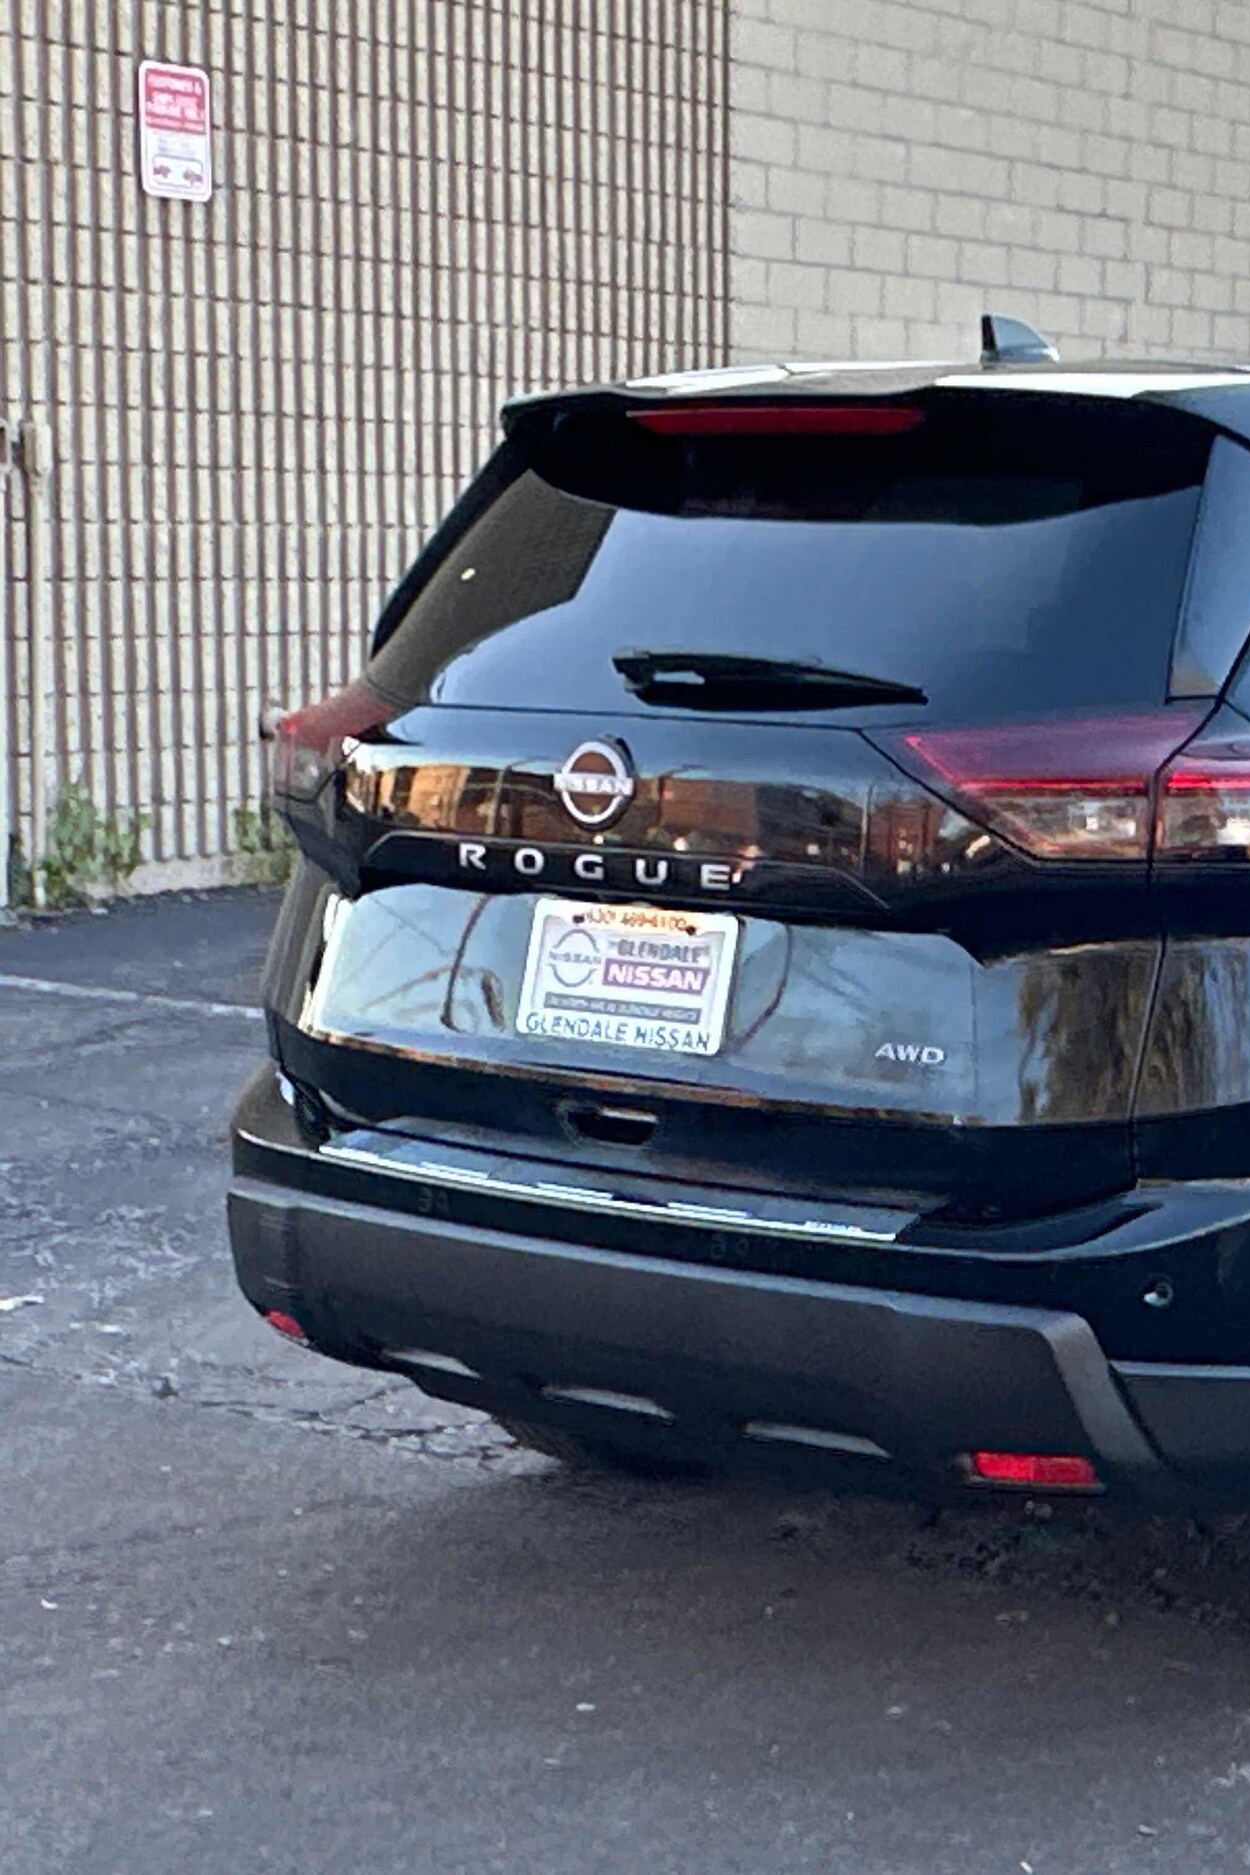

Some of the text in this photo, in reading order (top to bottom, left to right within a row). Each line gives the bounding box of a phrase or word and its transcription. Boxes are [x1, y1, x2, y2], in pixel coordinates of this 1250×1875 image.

[459, 843, 731, 890] ROGUE
[618, 939, 704, 963] GLENDALE
[608, 965, 704, 991] NISSAN
[526, 1012, 711, 1051] GLENDALE NISSAN
[874, 1042, 944, 1064] AWD
